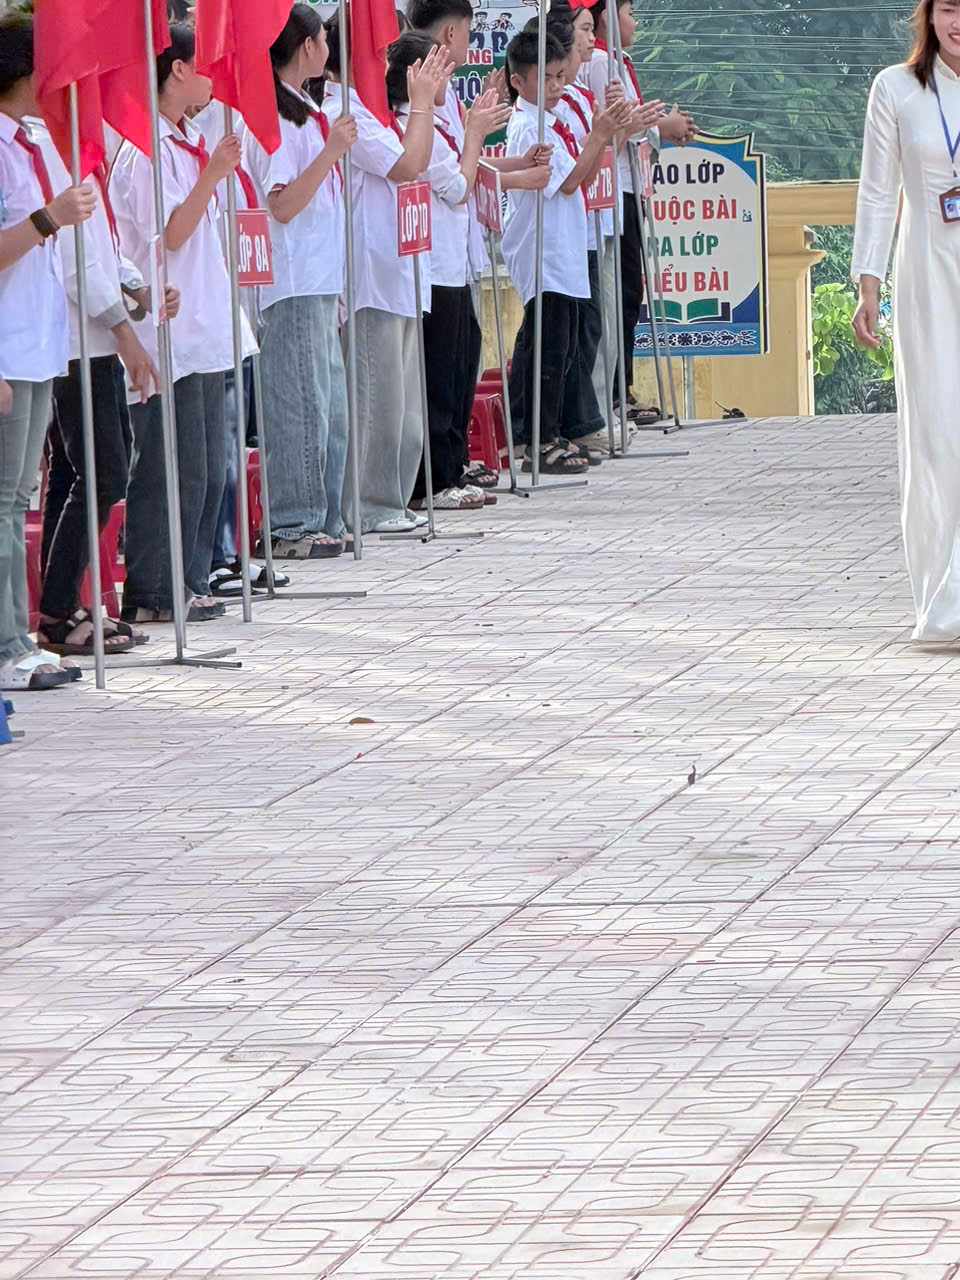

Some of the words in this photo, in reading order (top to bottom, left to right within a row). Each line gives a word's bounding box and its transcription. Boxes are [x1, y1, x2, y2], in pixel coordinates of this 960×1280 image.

[652, 161, 679, 184] ÀO
[685, 158, 725, 184] LỚP
[401, 197, 418, 243] LỚP
[702, 195, 737, 220] BÀI
[254, 234, 269, 272] 8A
[680, 231, 719, 256] LỚP
[654, 264, 687, 293] IỂU
[694, 267, 729, 292] BÀI
